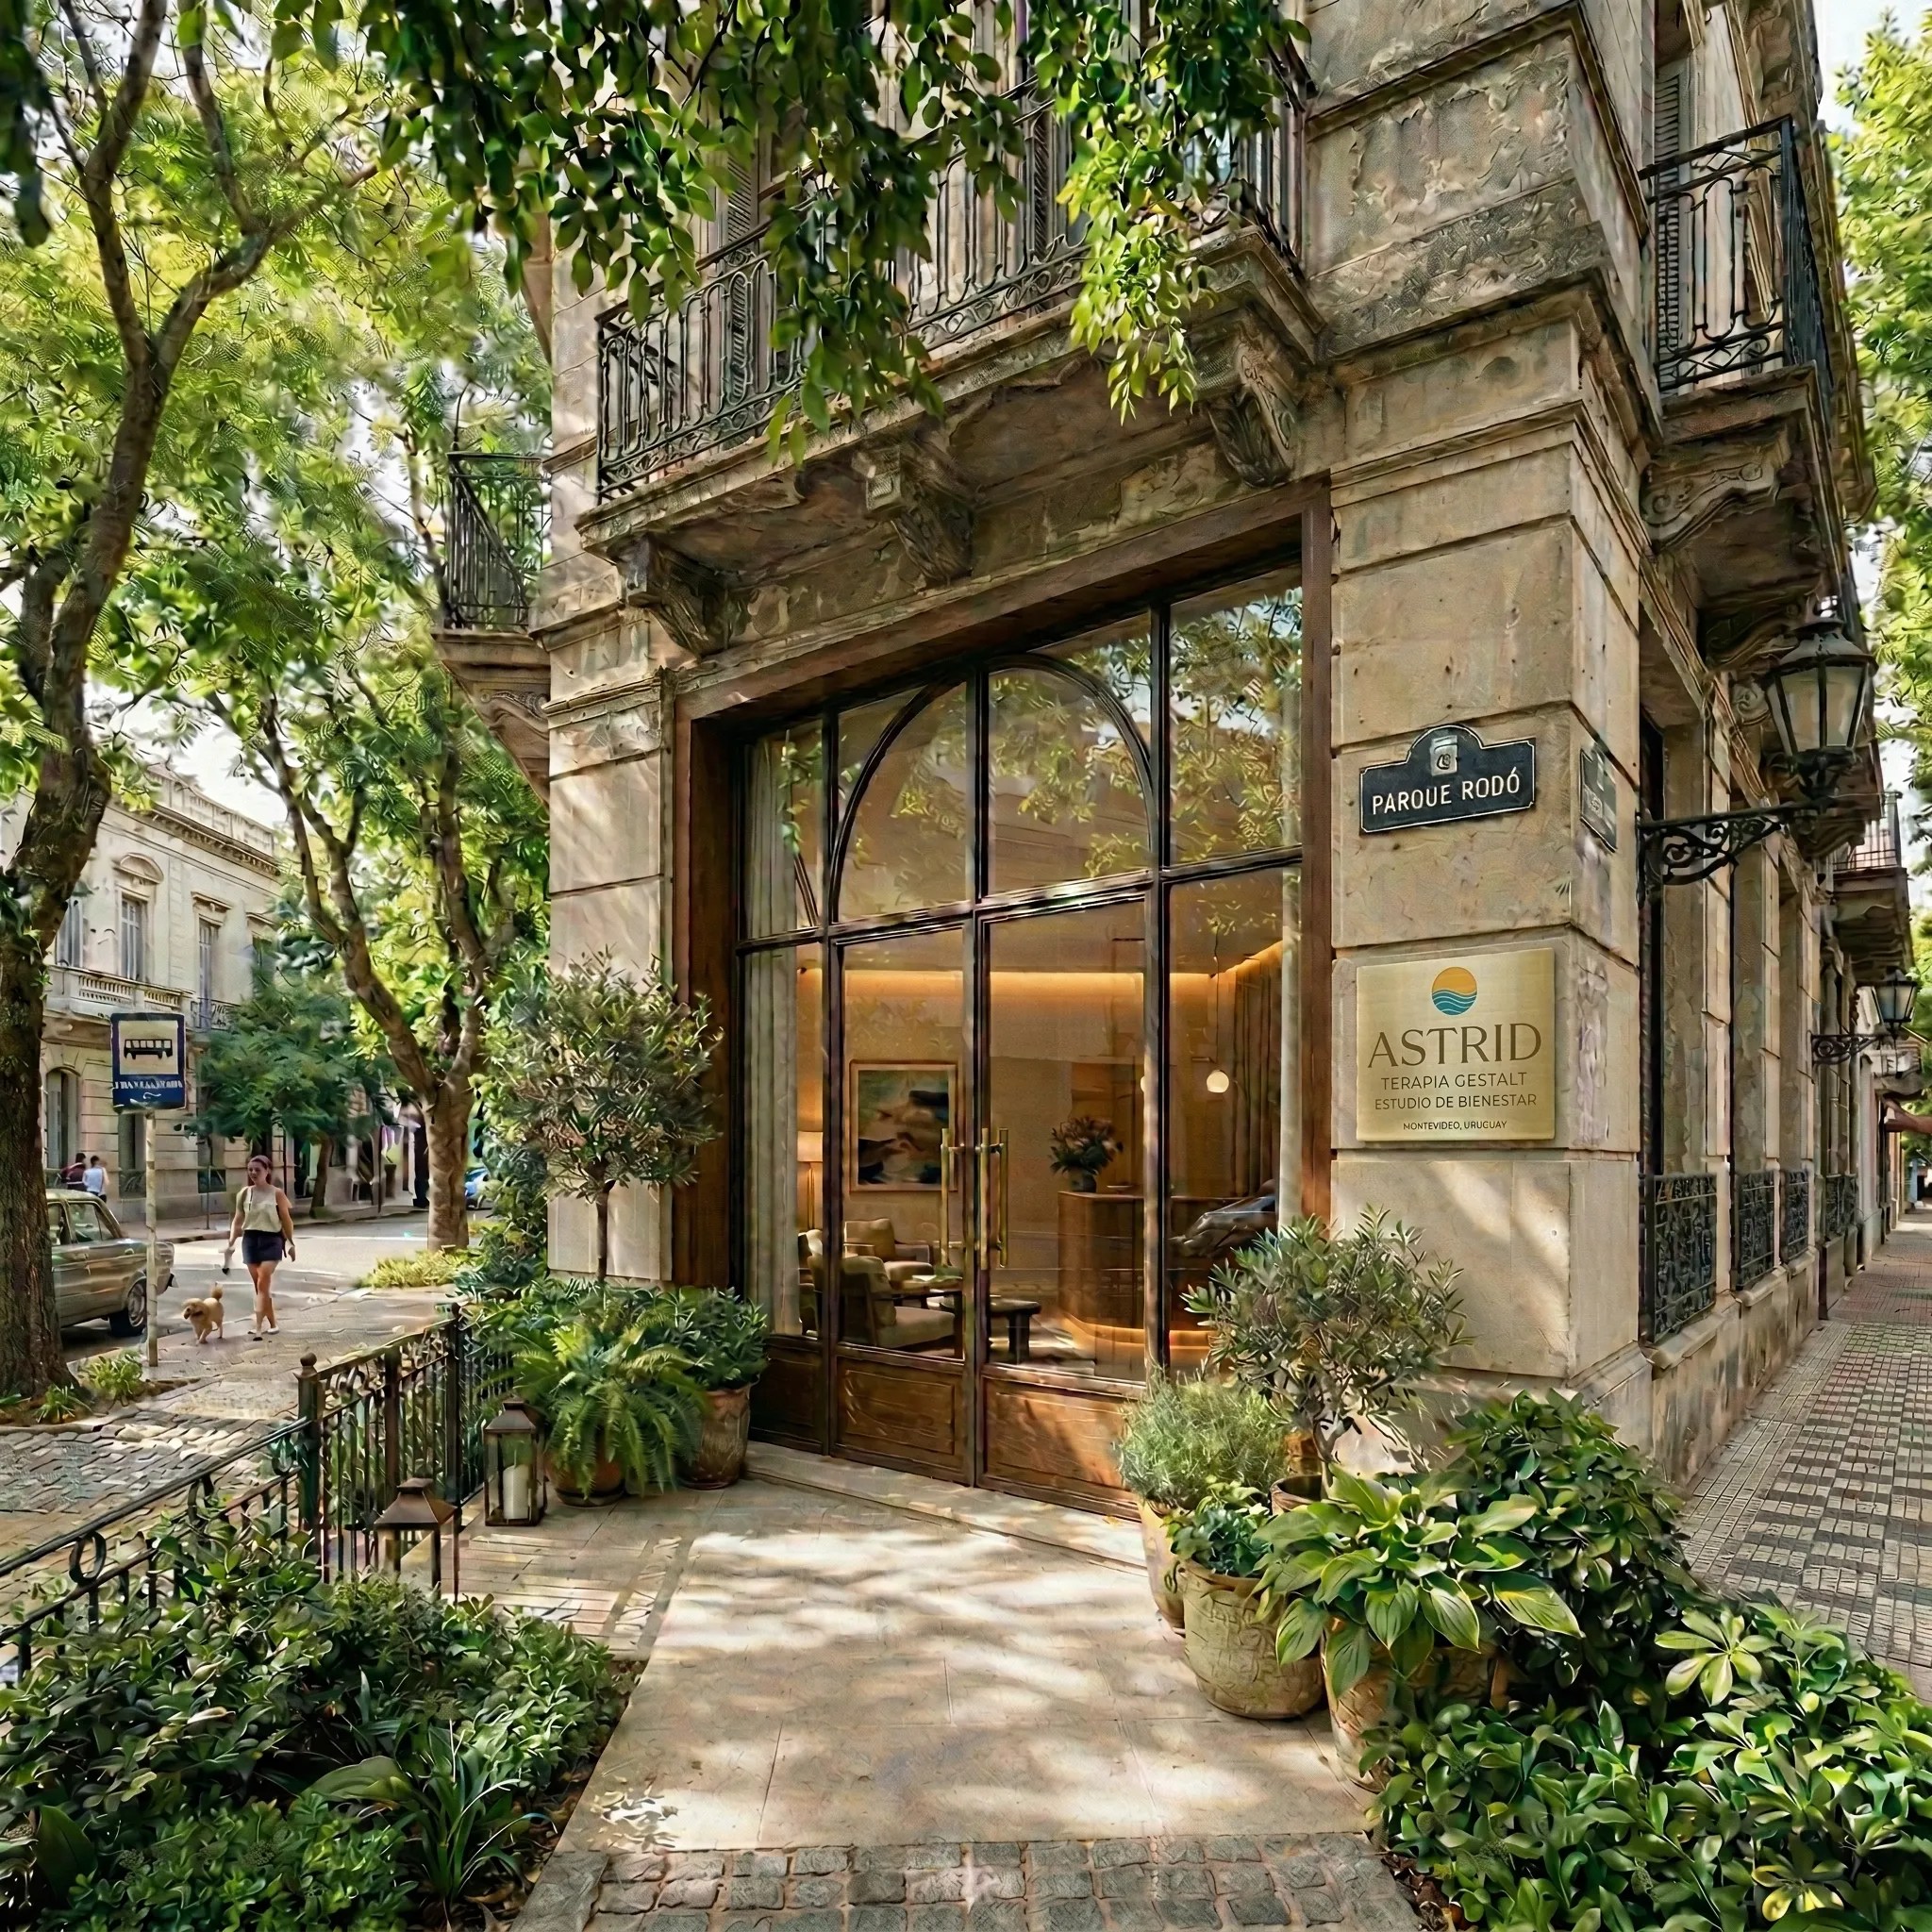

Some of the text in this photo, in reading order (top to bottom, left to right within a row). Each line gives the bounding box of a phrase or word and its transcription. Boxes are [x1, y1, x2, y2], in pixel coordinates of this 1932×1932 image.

[1462, 766, 1520, 800] RODÓ
[1368, 1023, 1541, 1068] ASTRID
[1381, 1072, 1527, 1090] TERAPIA GESTALT
[1374, 1093, 1537, 1109] ESTUDIO DE BIENESTAR
[1463, 1121, 1507, 1129] URUGUAY
